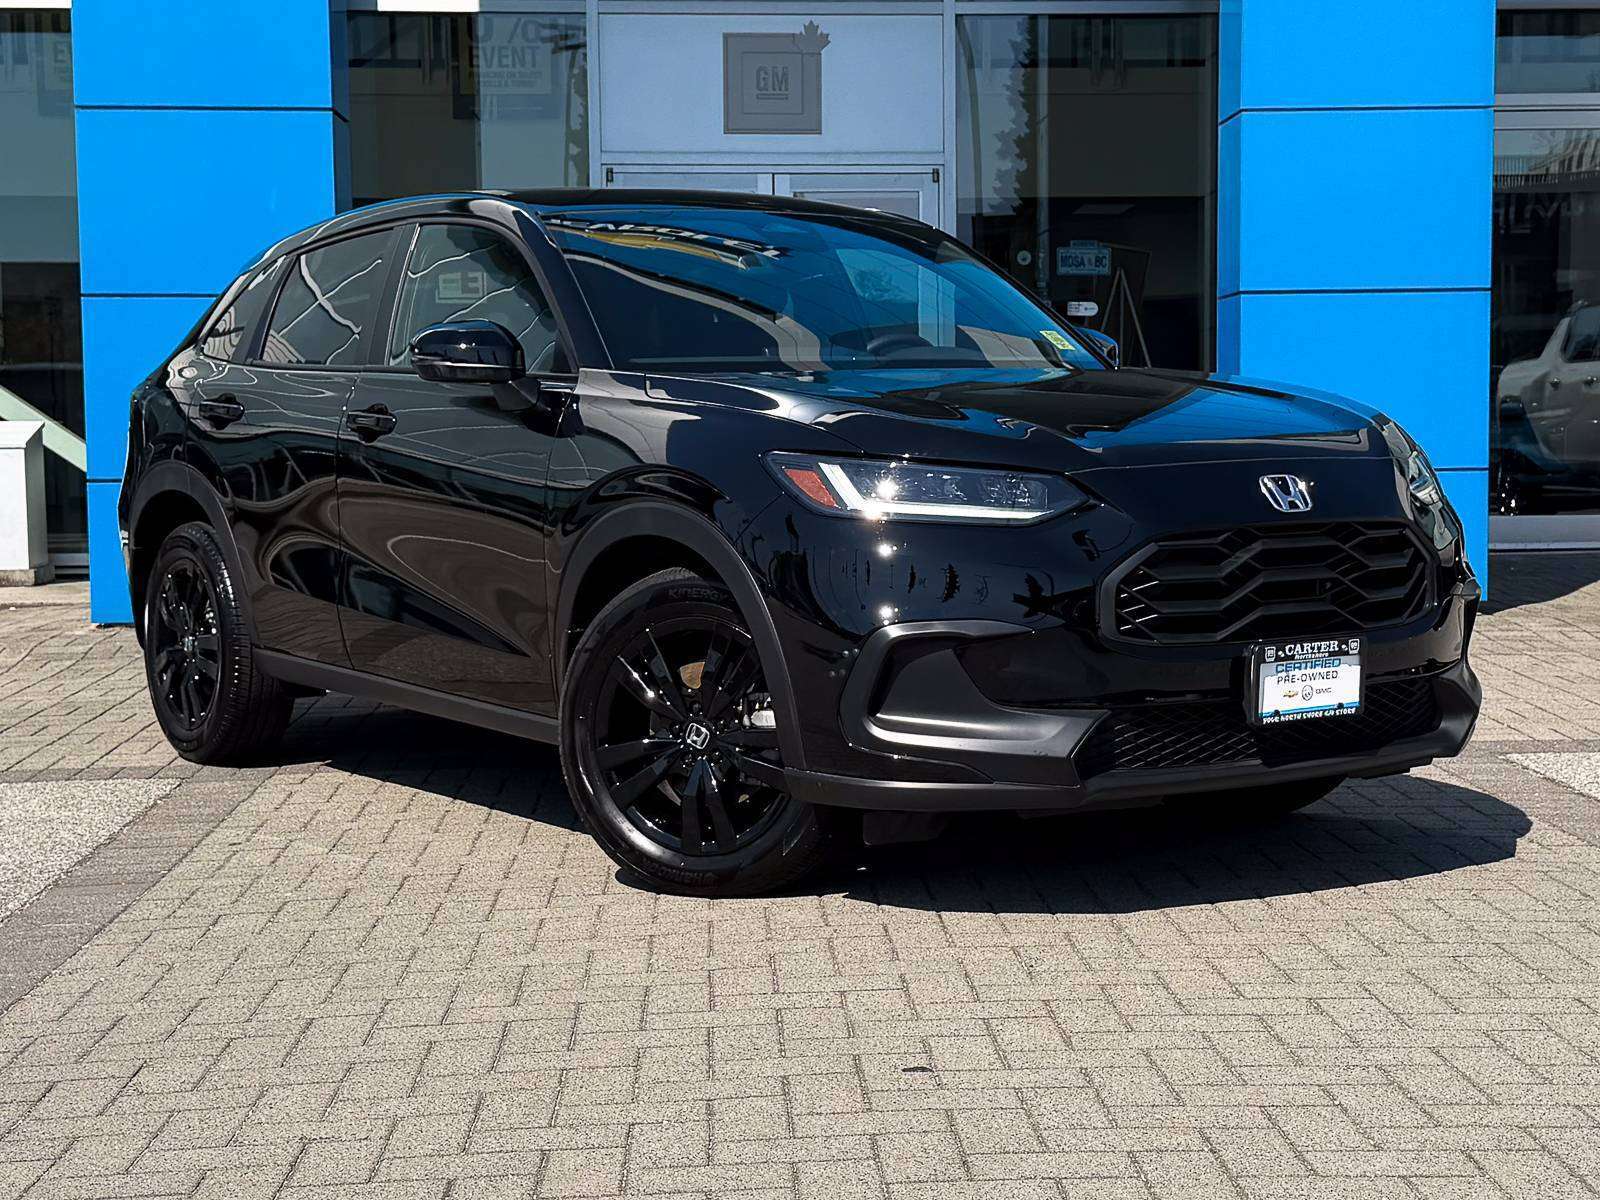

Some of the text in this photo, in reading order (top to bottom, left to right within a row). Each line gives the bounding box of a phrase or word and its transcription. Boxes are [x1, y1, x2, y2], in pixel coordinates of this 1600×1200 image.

[467, 45, 540, 69] EVENT
[756, 66, 789, 92] GM
[1285, 640, 1339, 656] CARTER
[1275, 658, 1341, 673] CERTIFIED
[1277, 670, 1339, 685] PRE-OWNED
[1315, 687, 1332, 695] GMC
